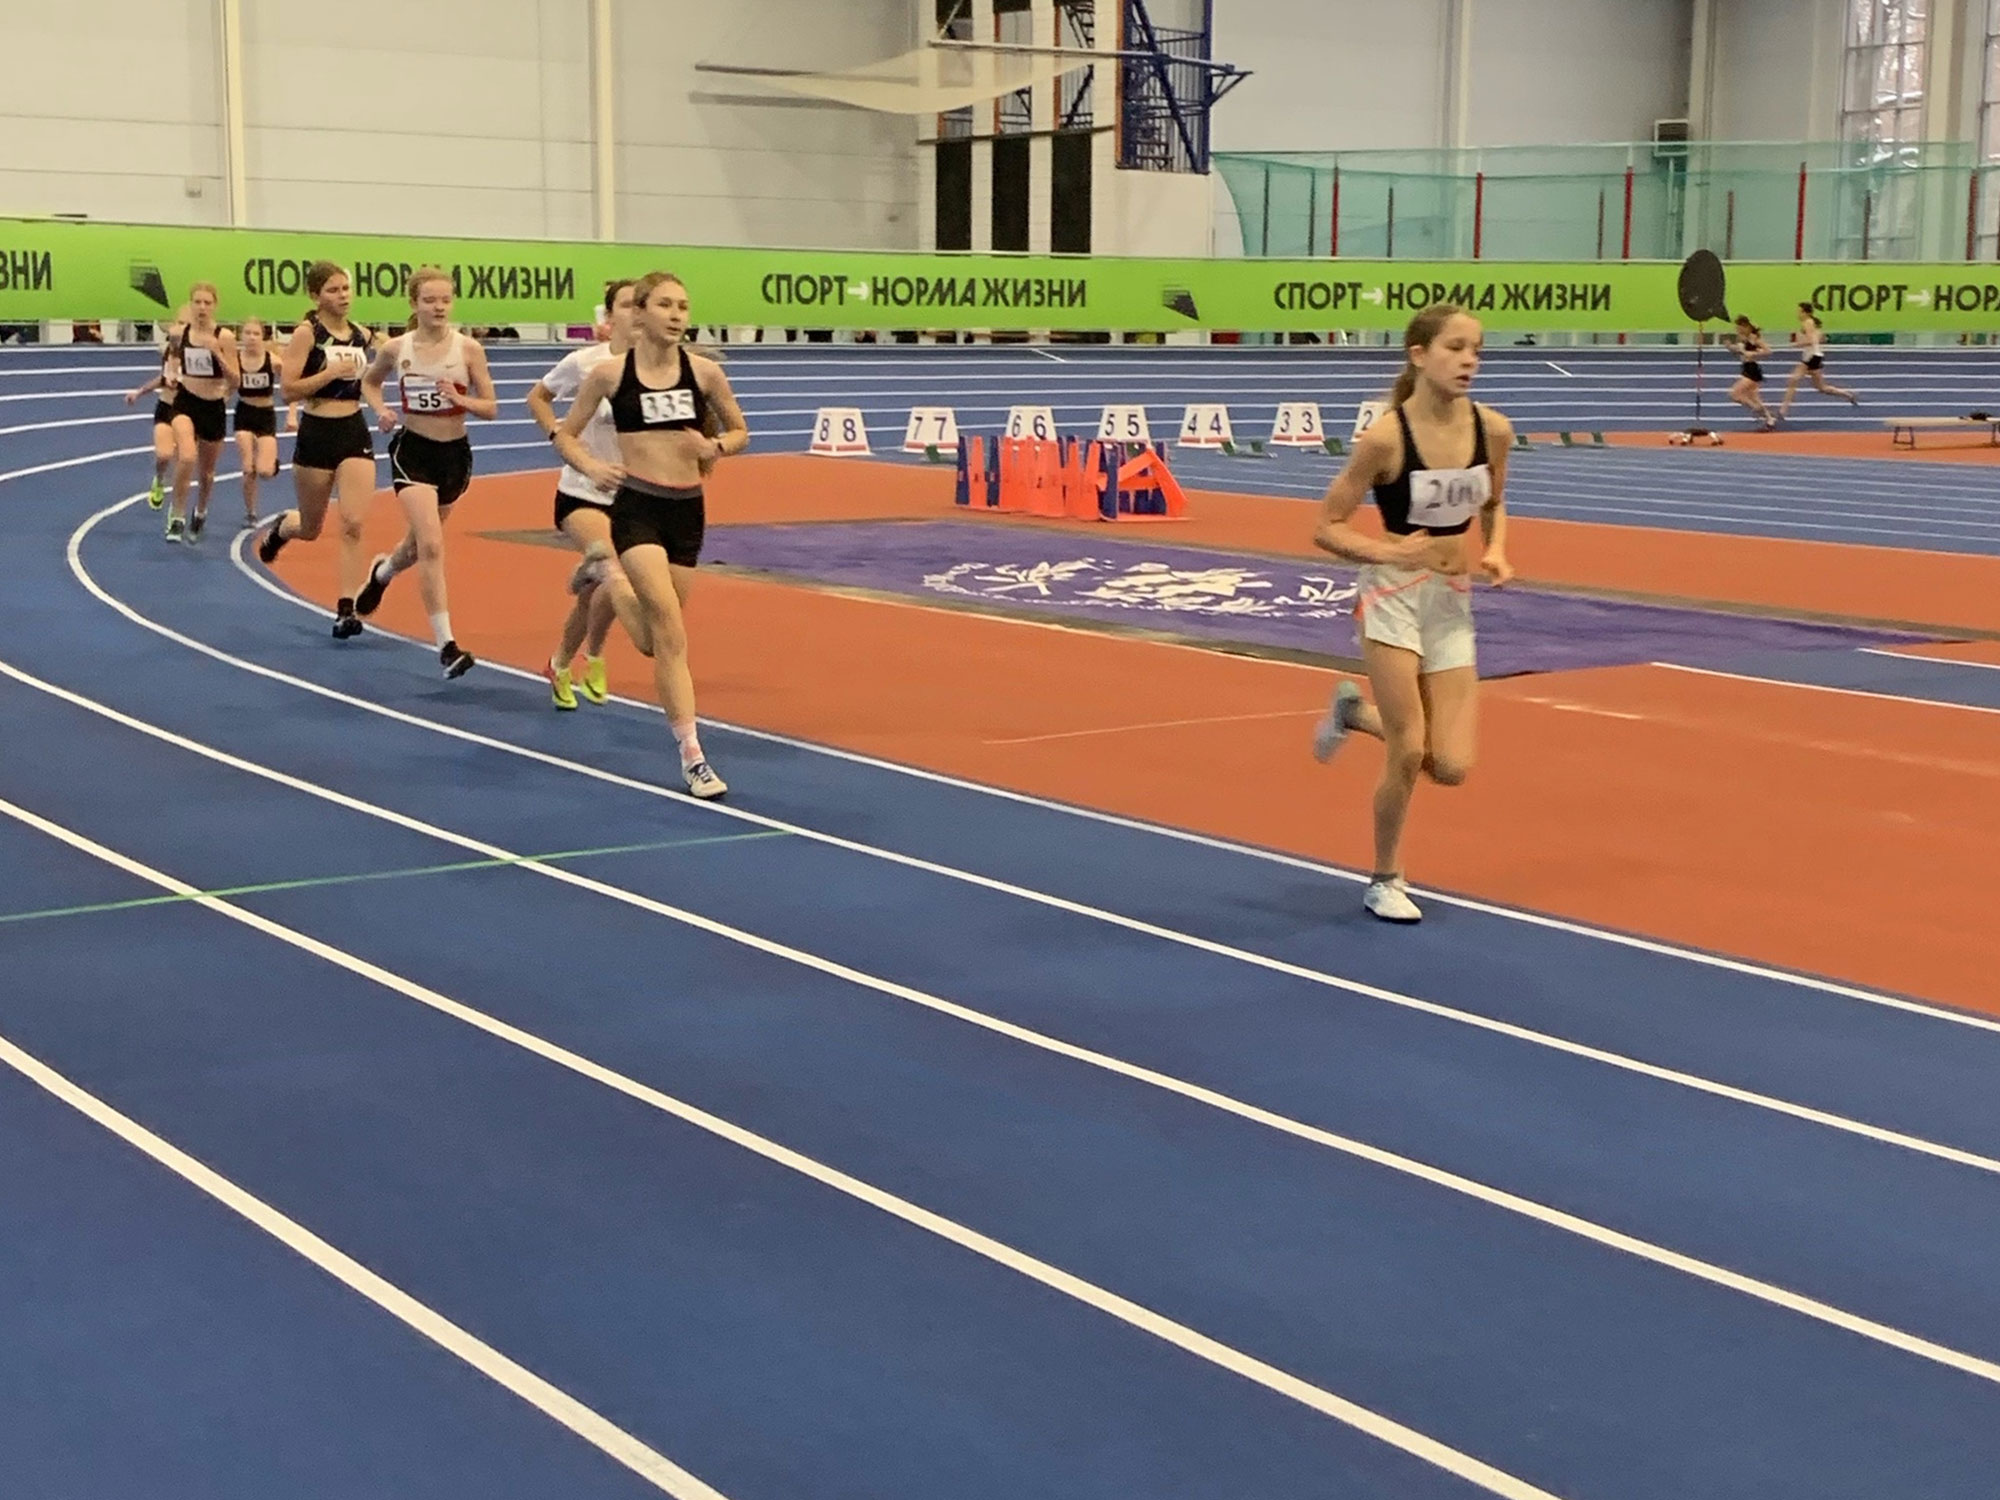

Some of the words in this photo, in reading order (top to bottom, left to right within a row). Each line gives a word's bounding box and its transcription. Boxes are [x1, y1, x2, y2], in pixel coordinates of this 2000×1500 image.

[355, 261, 462, 299] НОРА
[468, 265, 574, 300] ЖИЗНИ
[761, 273, 849, 305] СПОРТ
[872, 275, 976, 308] НОРМА
[981, 278, 1087, 308] ЖИЗНИ
[1274, 281, 1362, 310] СПОРТ
[1386, 282, 1496, 311] НОРМА
[1501, 283, 1611, 311] ЖИЗНИ
[1811, 284, 1908, 312] СПОРТ
[1934, 284, 2000, 312] НОР
[418, 393, 441, 408] 55
[819, 418, 830, 442] 8
[842, 418, 856, 442] 8
[914, 416, 923, 440] 7
[934, 416, 947, 441] 7
[1012, 414, 1022, 437] 6
[1033, 414, 1047, 439] 6
[1105, 413, 1115, 436] 5
[1127, 414, 1140, 437] 5
[1188, 412, 1198, 435] 4
[1210, 412, 1222, 435] 4
[1280, 411, 1291, 433] 3
[1302, 411, 1314, 433] 3
